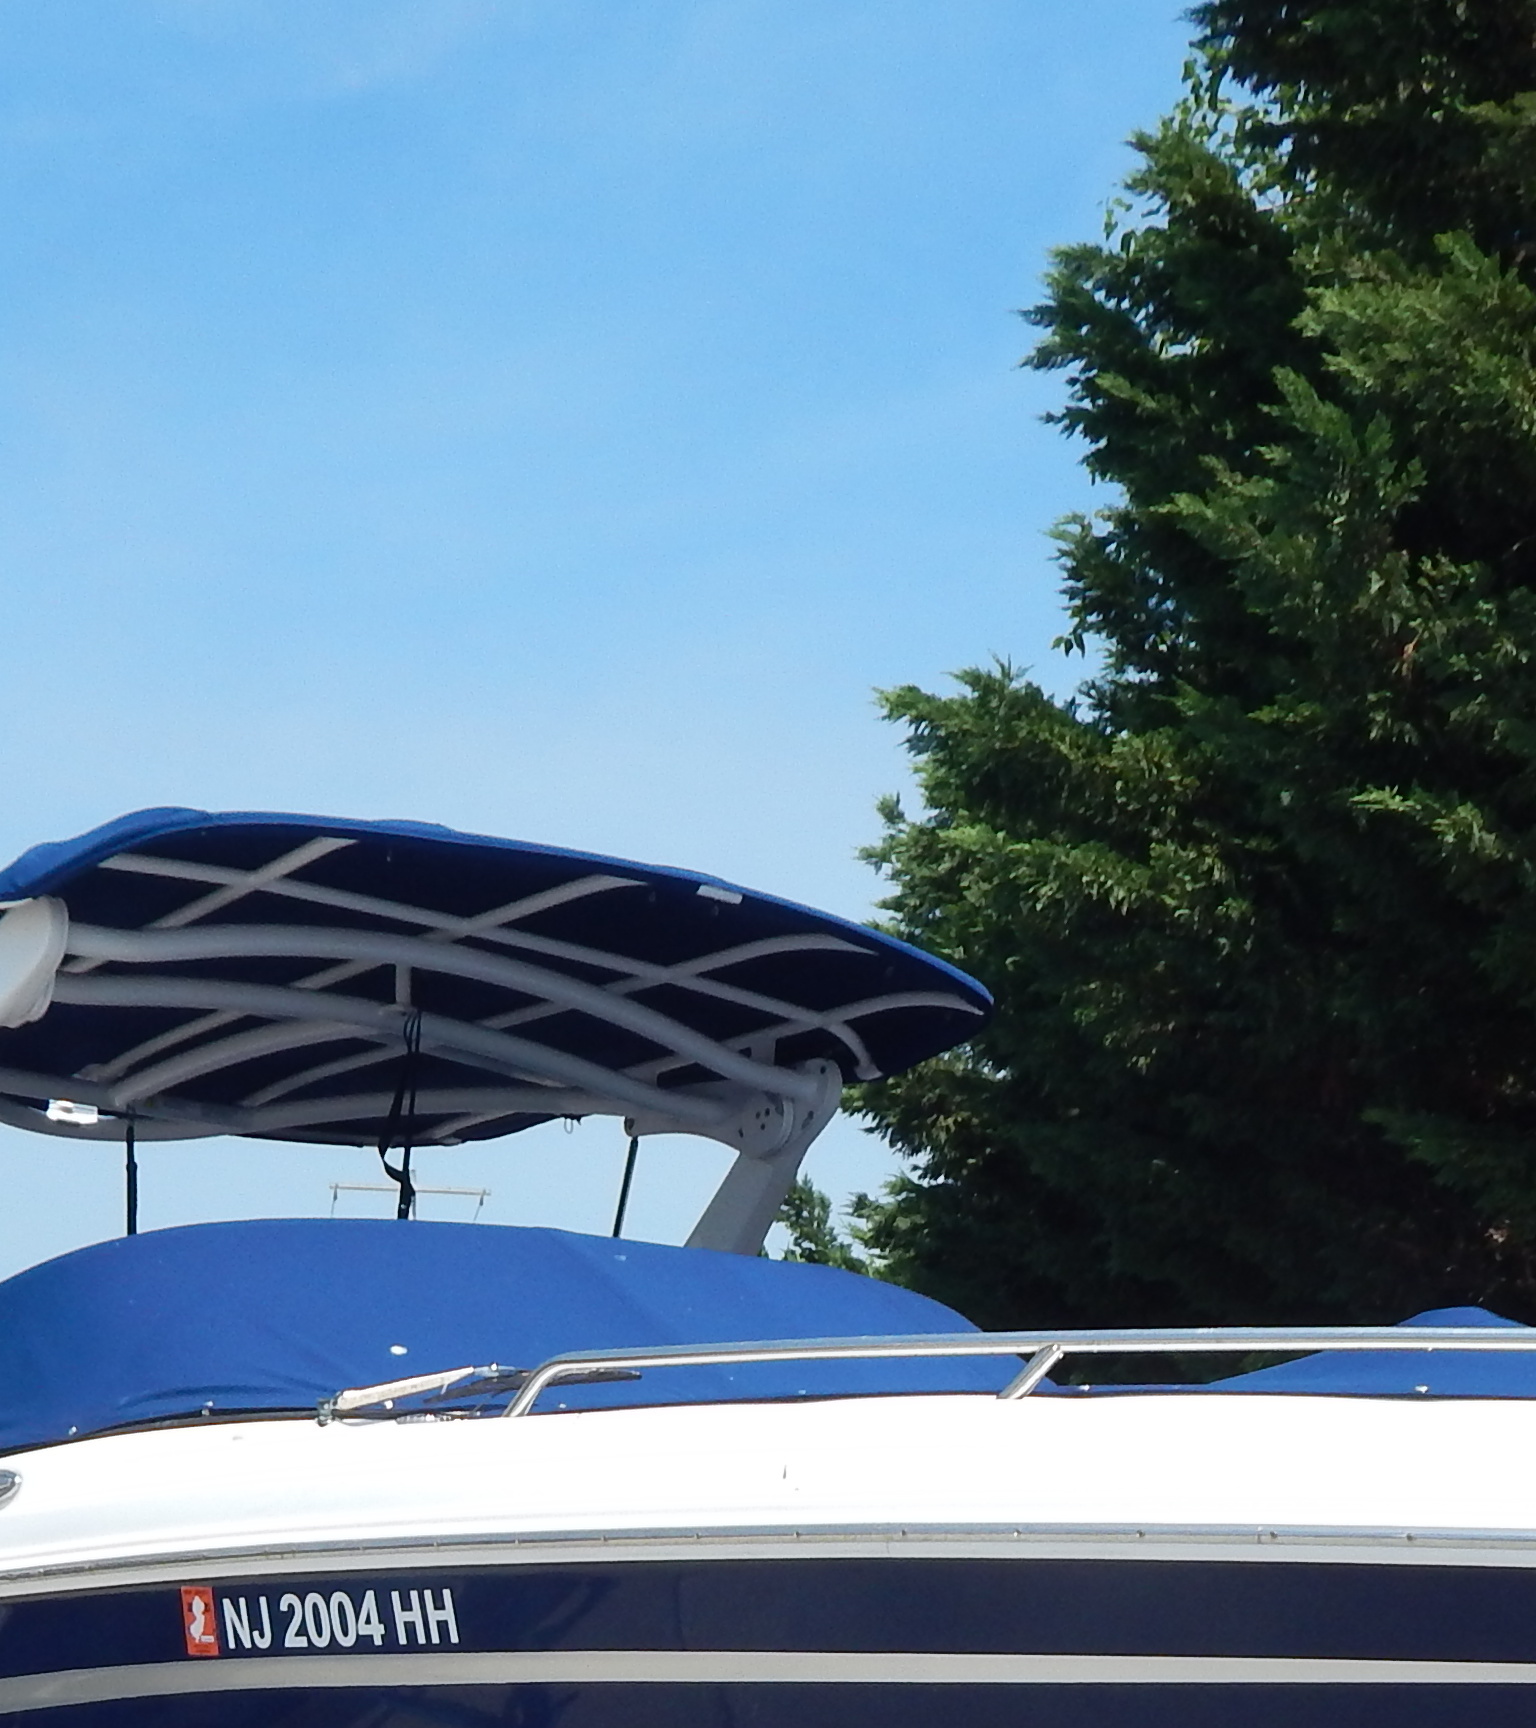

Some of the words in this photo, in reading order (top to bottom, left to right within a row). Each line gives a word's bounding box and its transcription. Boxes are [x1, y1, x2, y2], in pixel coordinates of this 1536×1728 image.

[221, 1596, 272, 1649] NJ
[279, 1590, 385, 1648] 2004
[390, 1588, 459, 1645] HH
